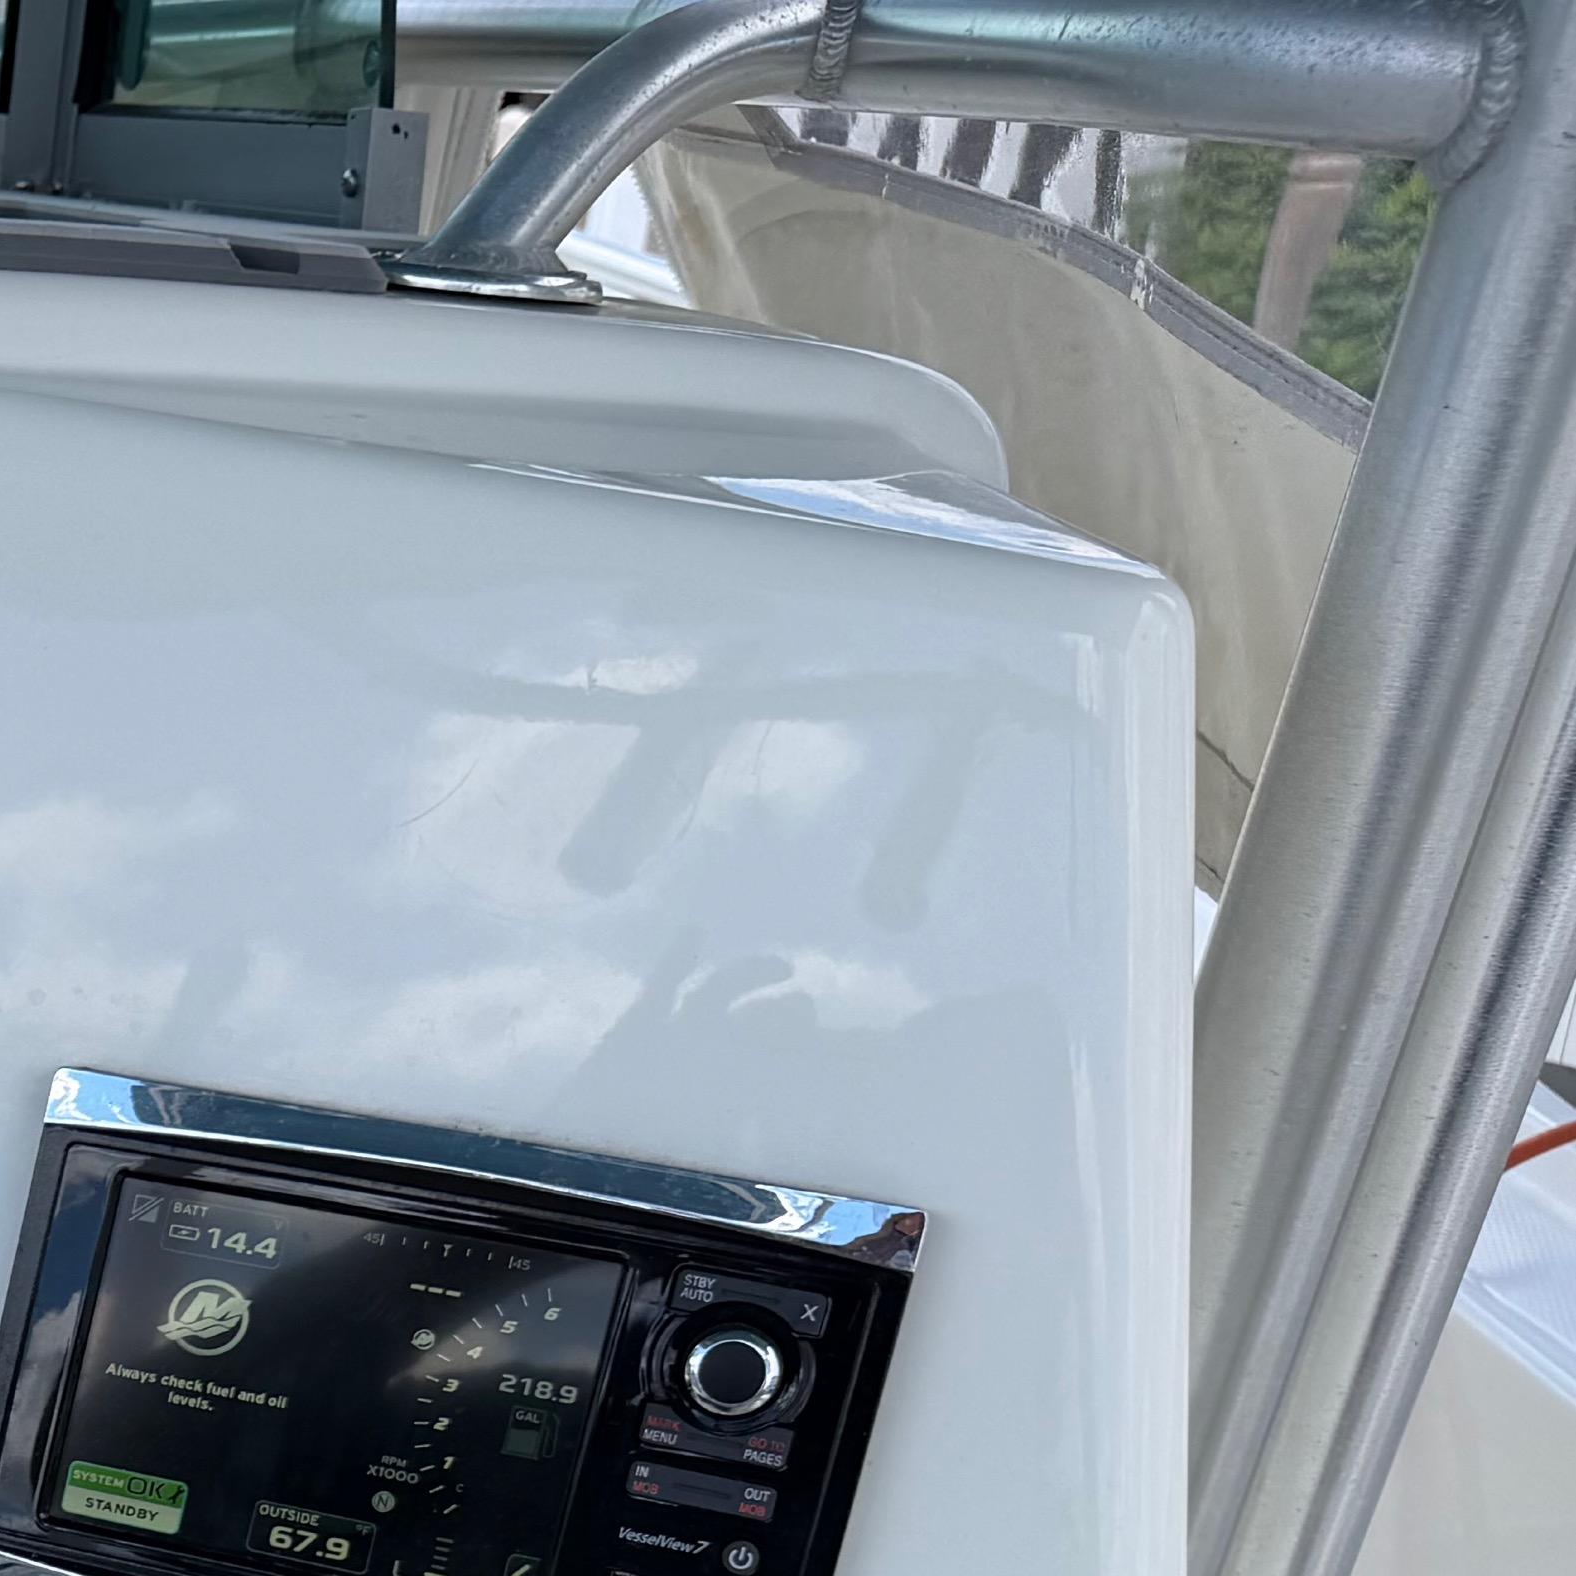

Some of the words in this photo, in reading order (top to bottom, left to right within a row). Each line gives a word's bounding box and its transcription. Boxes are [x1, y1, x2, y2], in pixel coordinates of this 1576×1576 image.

[172, 1202, 209, 1218] BATT
[206, 1227, 278, 1259] 14.4
[683, 1274, 716, 1289] STBY
[680, 1287, 714, 1302] AUTO
[543, 1307, 562, 1321] 6
[499, 1320, 519, 1334] 5
[466, 1346, 483, 1359] 4
[105, 1363, 157, 1384] Always
[161, 1374, 201, 1393] check
[206, 1382, 236, 1399] fuel
[237, 1389, 266, 1405] and
[268, 1394, 287, 1409] oil
[442, 1379, 460, 1392] 3
[498, 1374, 579, 1404] 218.9
[168, 1391, 214, 1411] levels.
[433, 1417, 451, 1431] 2
[515, 1410, 540, 1424] GAL
[642, 1428, 678, 1445] MENU
[381, 1455, 406, 1467] RPM
[743, 1449, 783, 1466] PAGES
[635, 1465, 649, 1478] IN
[72, 1469, 125, 1489] SYSTEM
[127, 1476, 165, 1499] OK
[632, 1480, 660, 1495] MOB
[744, 1487, 771, 1502] OUT
[85, 1497, 159, 1522] STANDBY
[258, 1504, 321, 1527] OUTSIDE
[738, 1502, 767, 1517] MOB
[269, 1525, 351, 1561] 67.9
